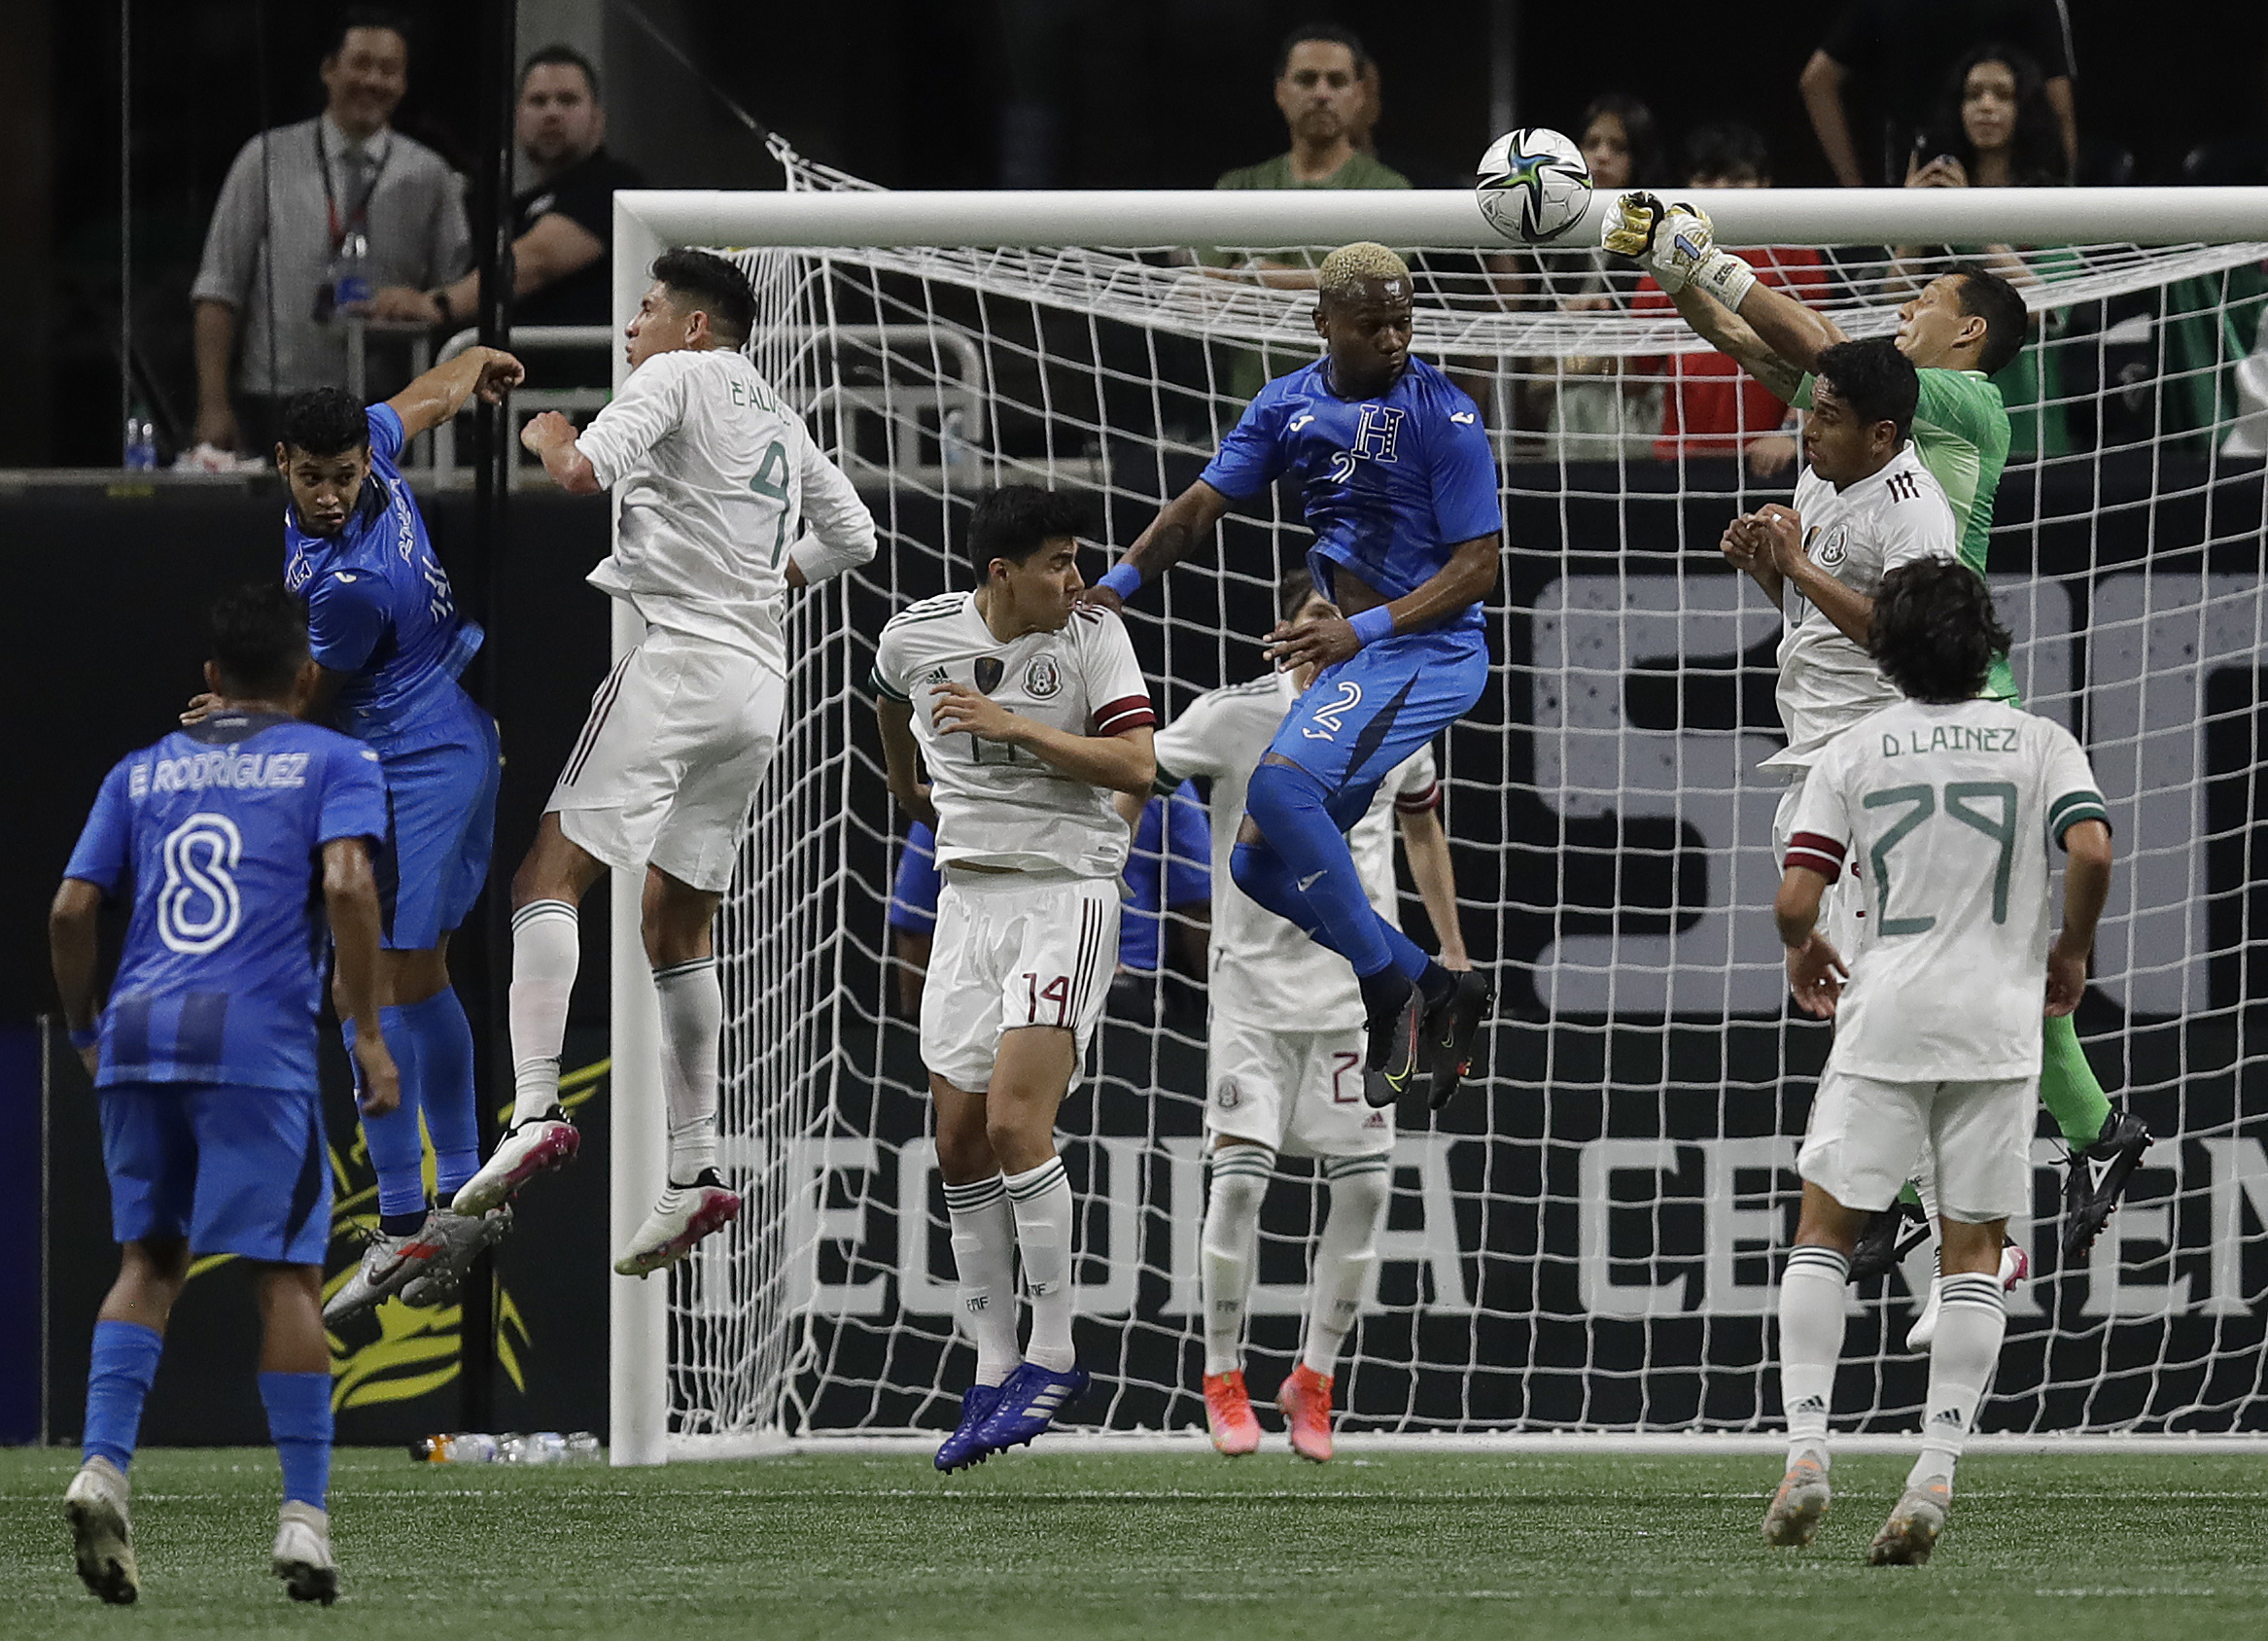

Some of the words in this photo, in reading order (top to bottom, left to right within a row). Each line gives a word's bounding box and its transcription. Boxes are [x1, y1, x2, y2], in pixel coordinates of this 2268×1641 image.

[1350, 403, 1405, 464] H
[749, 439, 790, 571] 4
[1311, 681, 1362, 732] 2
[153, 743, 311, 794] RODRÍGUEZ
[1883, 734, 1905, 757] D.
[157, 811, 242, 955] 8
[1864, 782, 2018, 937] 29
[1022, 972, 1069, 1028] 14
